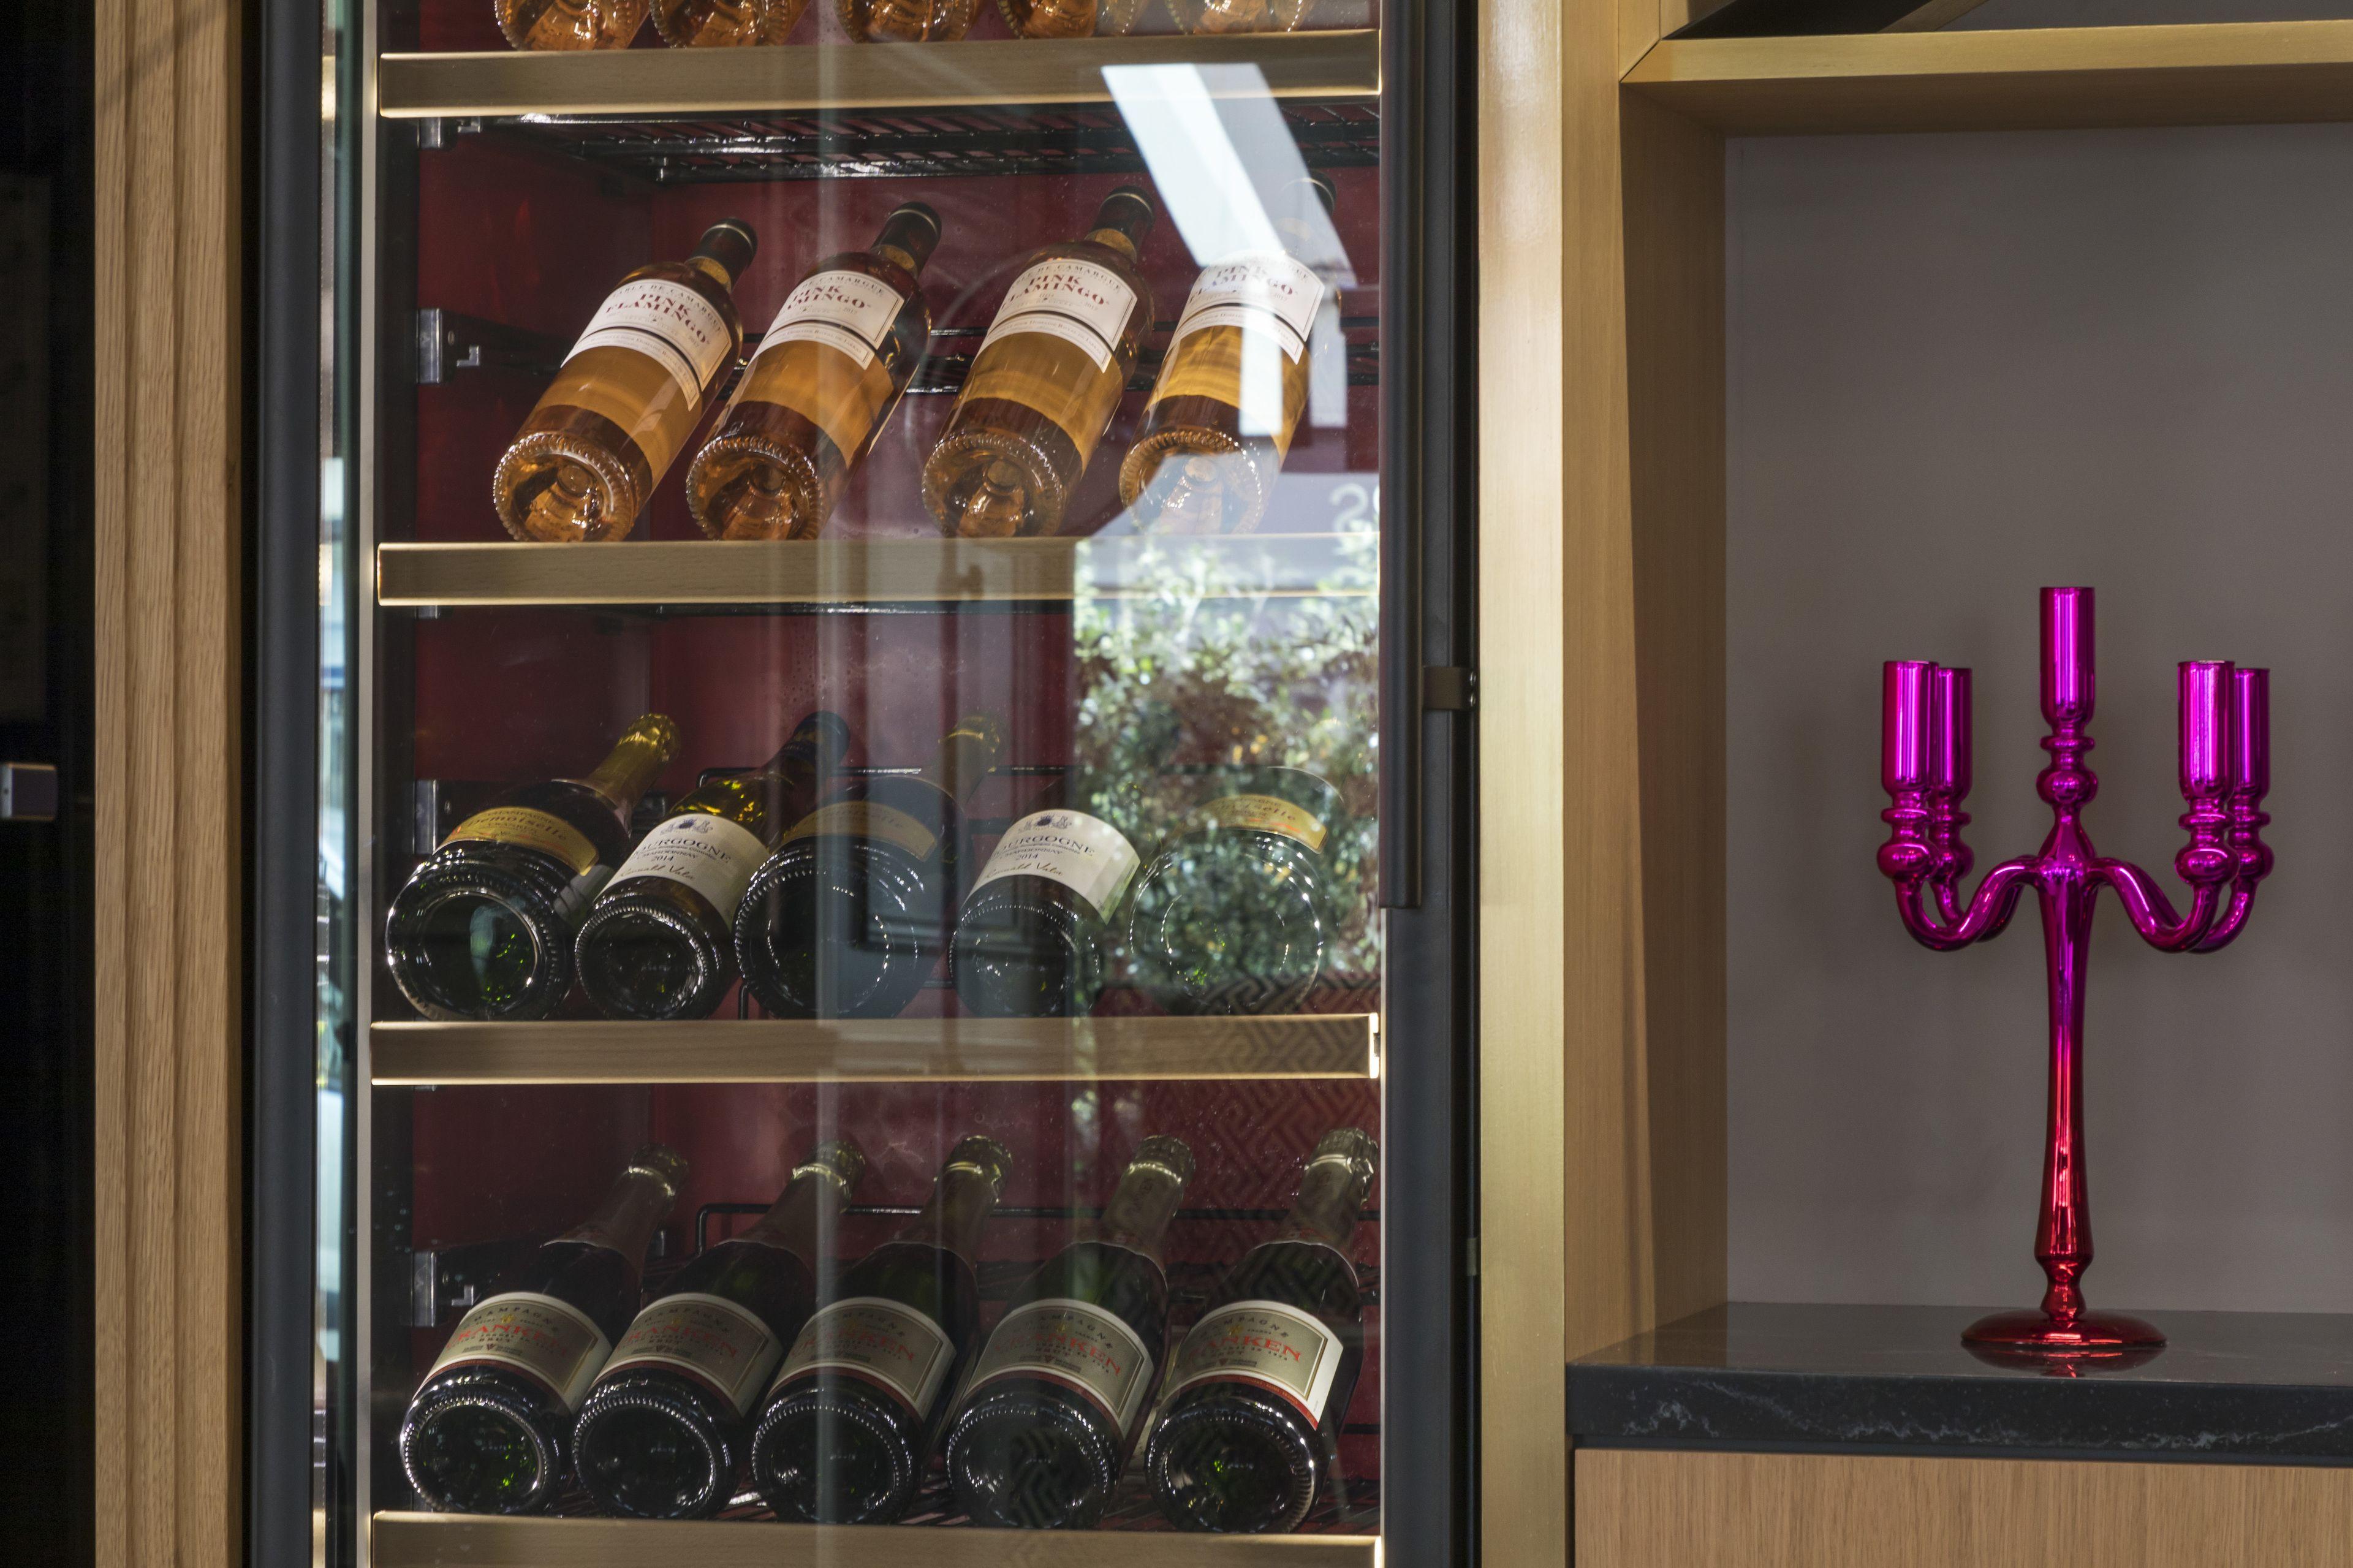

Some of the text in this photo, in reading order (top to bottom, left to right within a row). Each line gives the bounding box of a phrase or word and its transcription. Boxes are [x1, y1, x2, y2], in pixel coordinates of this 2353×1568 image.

[1029, 274, 1082, 287] PINK
[1057, 264, 1121, 290] CAMARGUE
[1216, 266, 1267, 278] PINK
[792, 285, 841, 303] PINK
[819, 275, 884, 292] CAMARGUE
[640, 294, 692, 317] PINK
[670, 288, 721, 333] CAMARGUE
[786, 293, 865, 311] AMINGO
[1084, 301, 1099, 311] 2017
[605, 300, 707, 344] FLAMINGO
[1023, 1314, 1113, 1349] HAMPAGNE
[1200, 1317, 1289, 1338] HAMPAGNE
[616, 1325, 737, 1358] RANKEN
[1188, 1335, 1301, 1362] RANKEN
